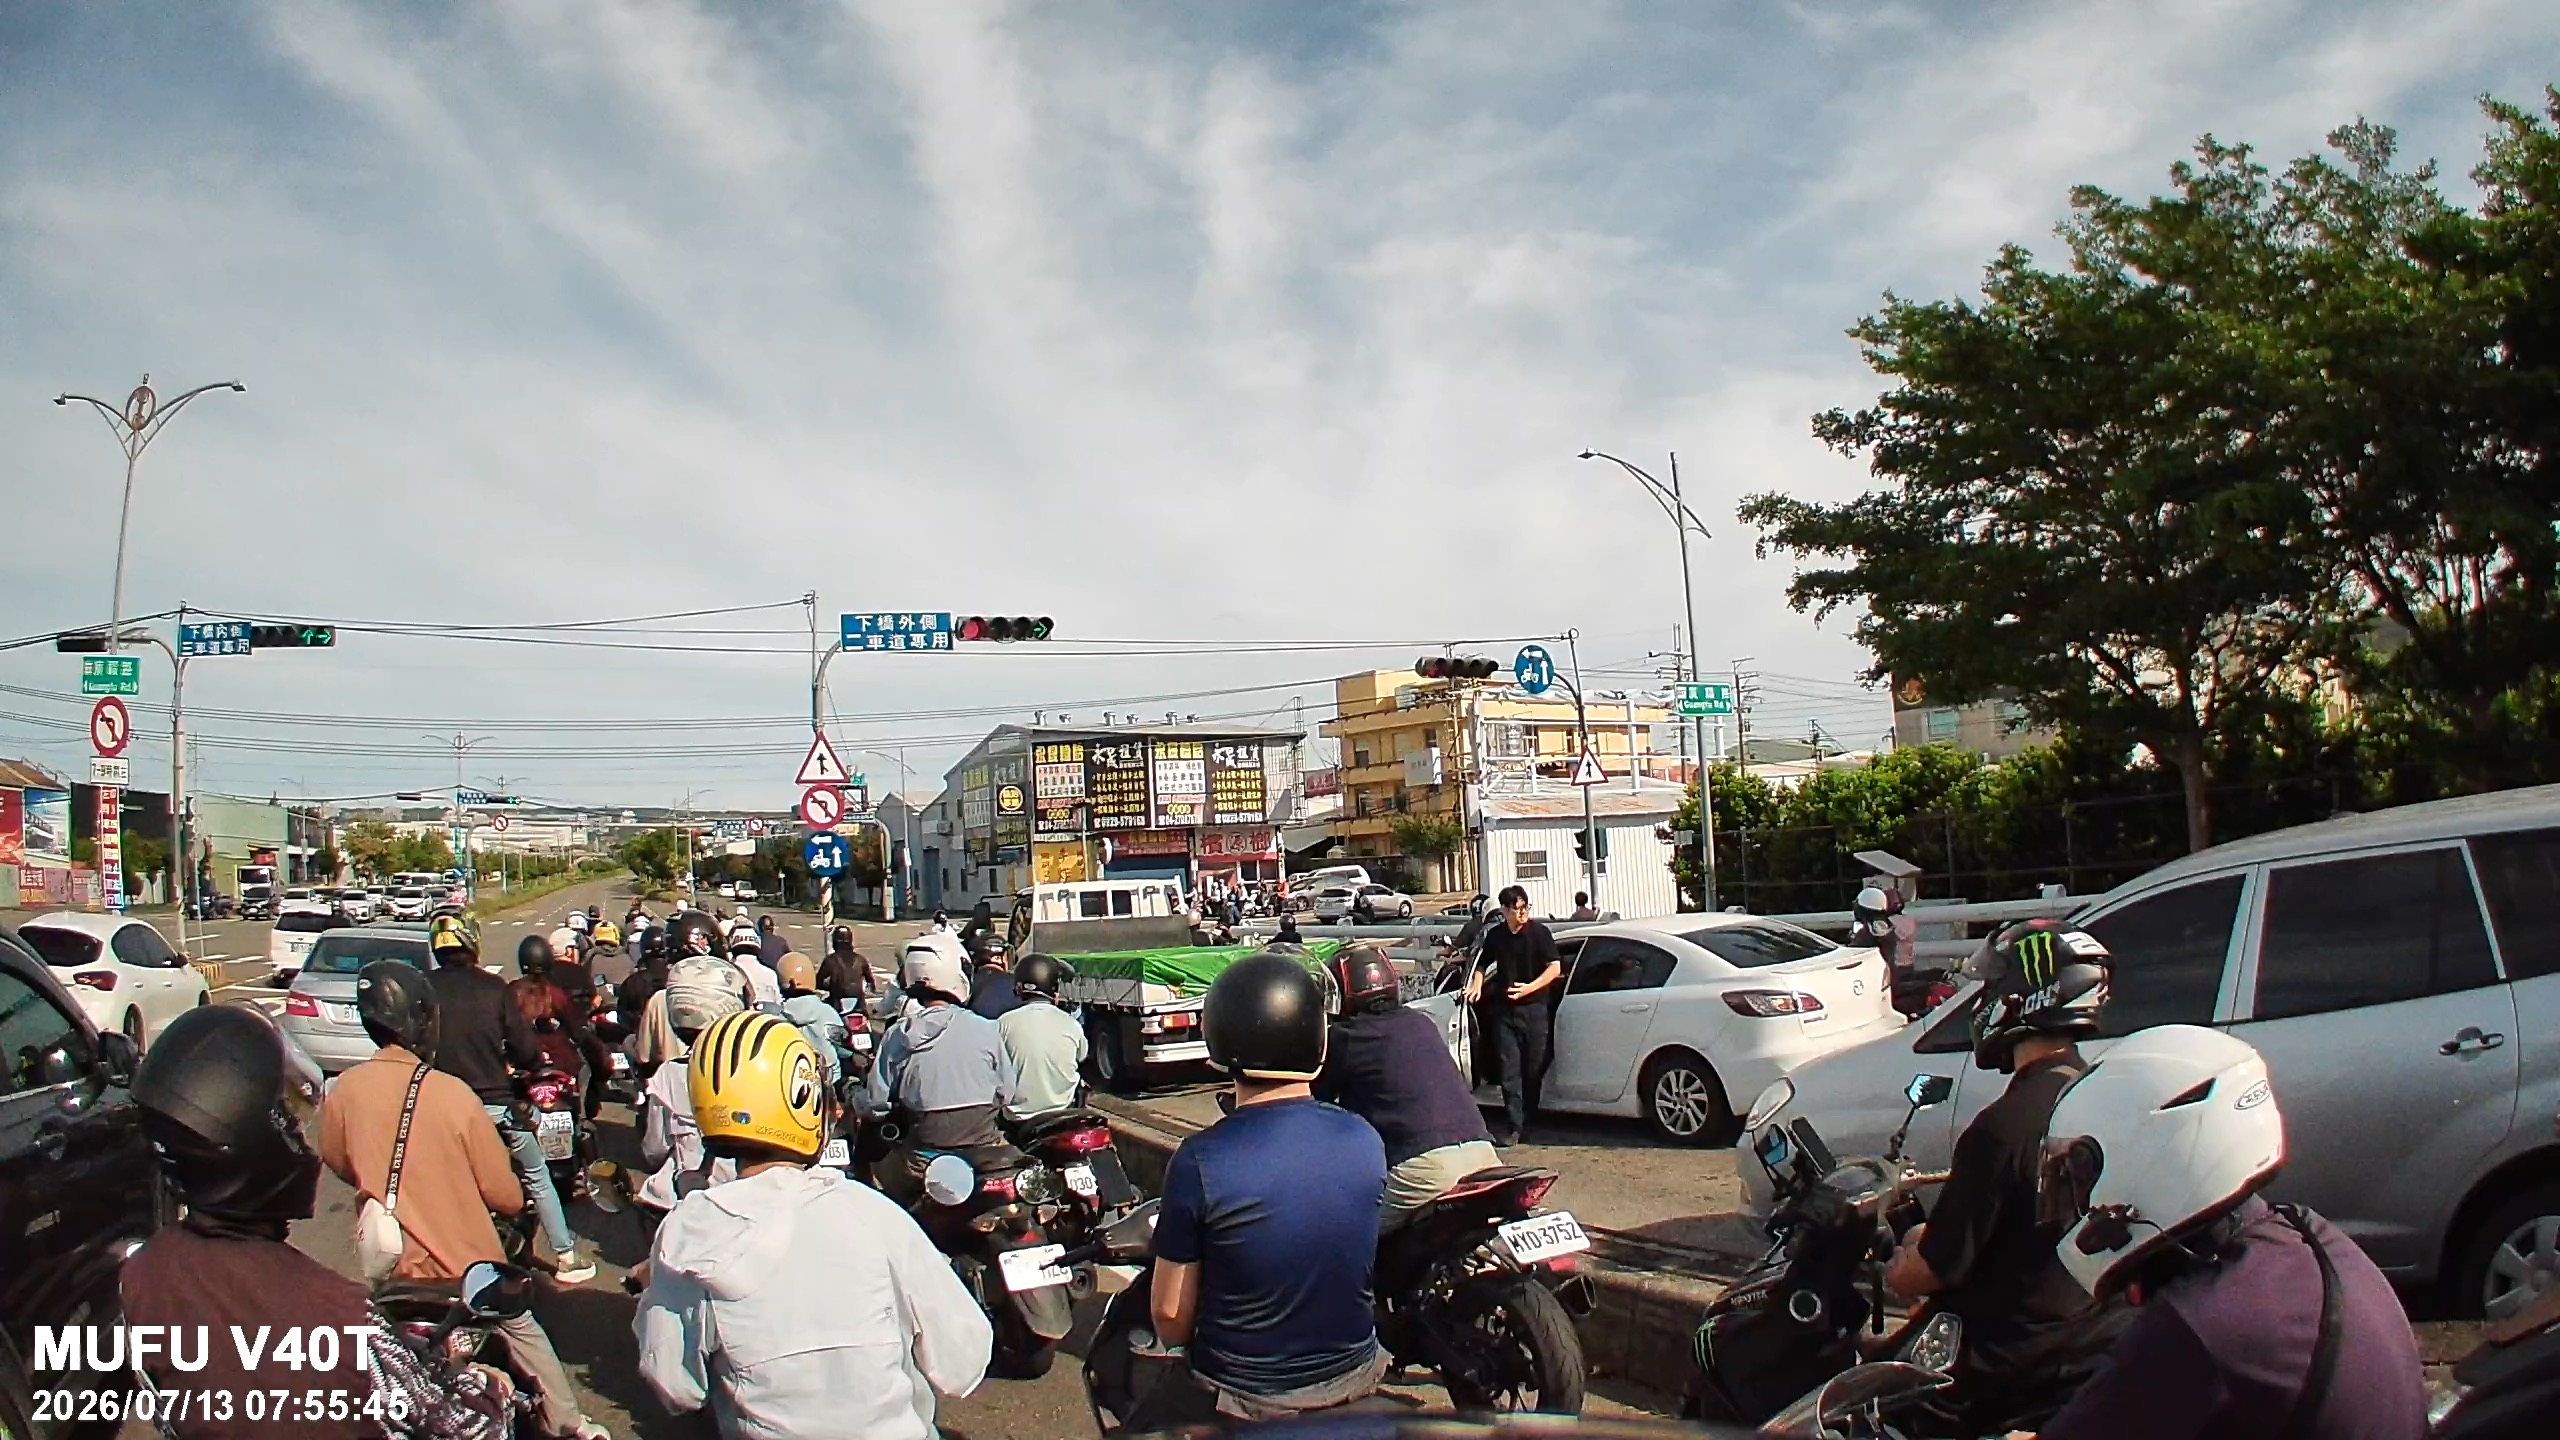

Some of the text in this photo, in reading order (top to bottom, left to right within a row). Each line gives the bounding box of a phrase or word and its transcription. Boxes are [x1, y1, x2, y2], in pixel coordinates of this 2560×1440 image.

[854, 613, 938, 632] 下橋外側
[844, 631, 949, 651] 二車道專用
